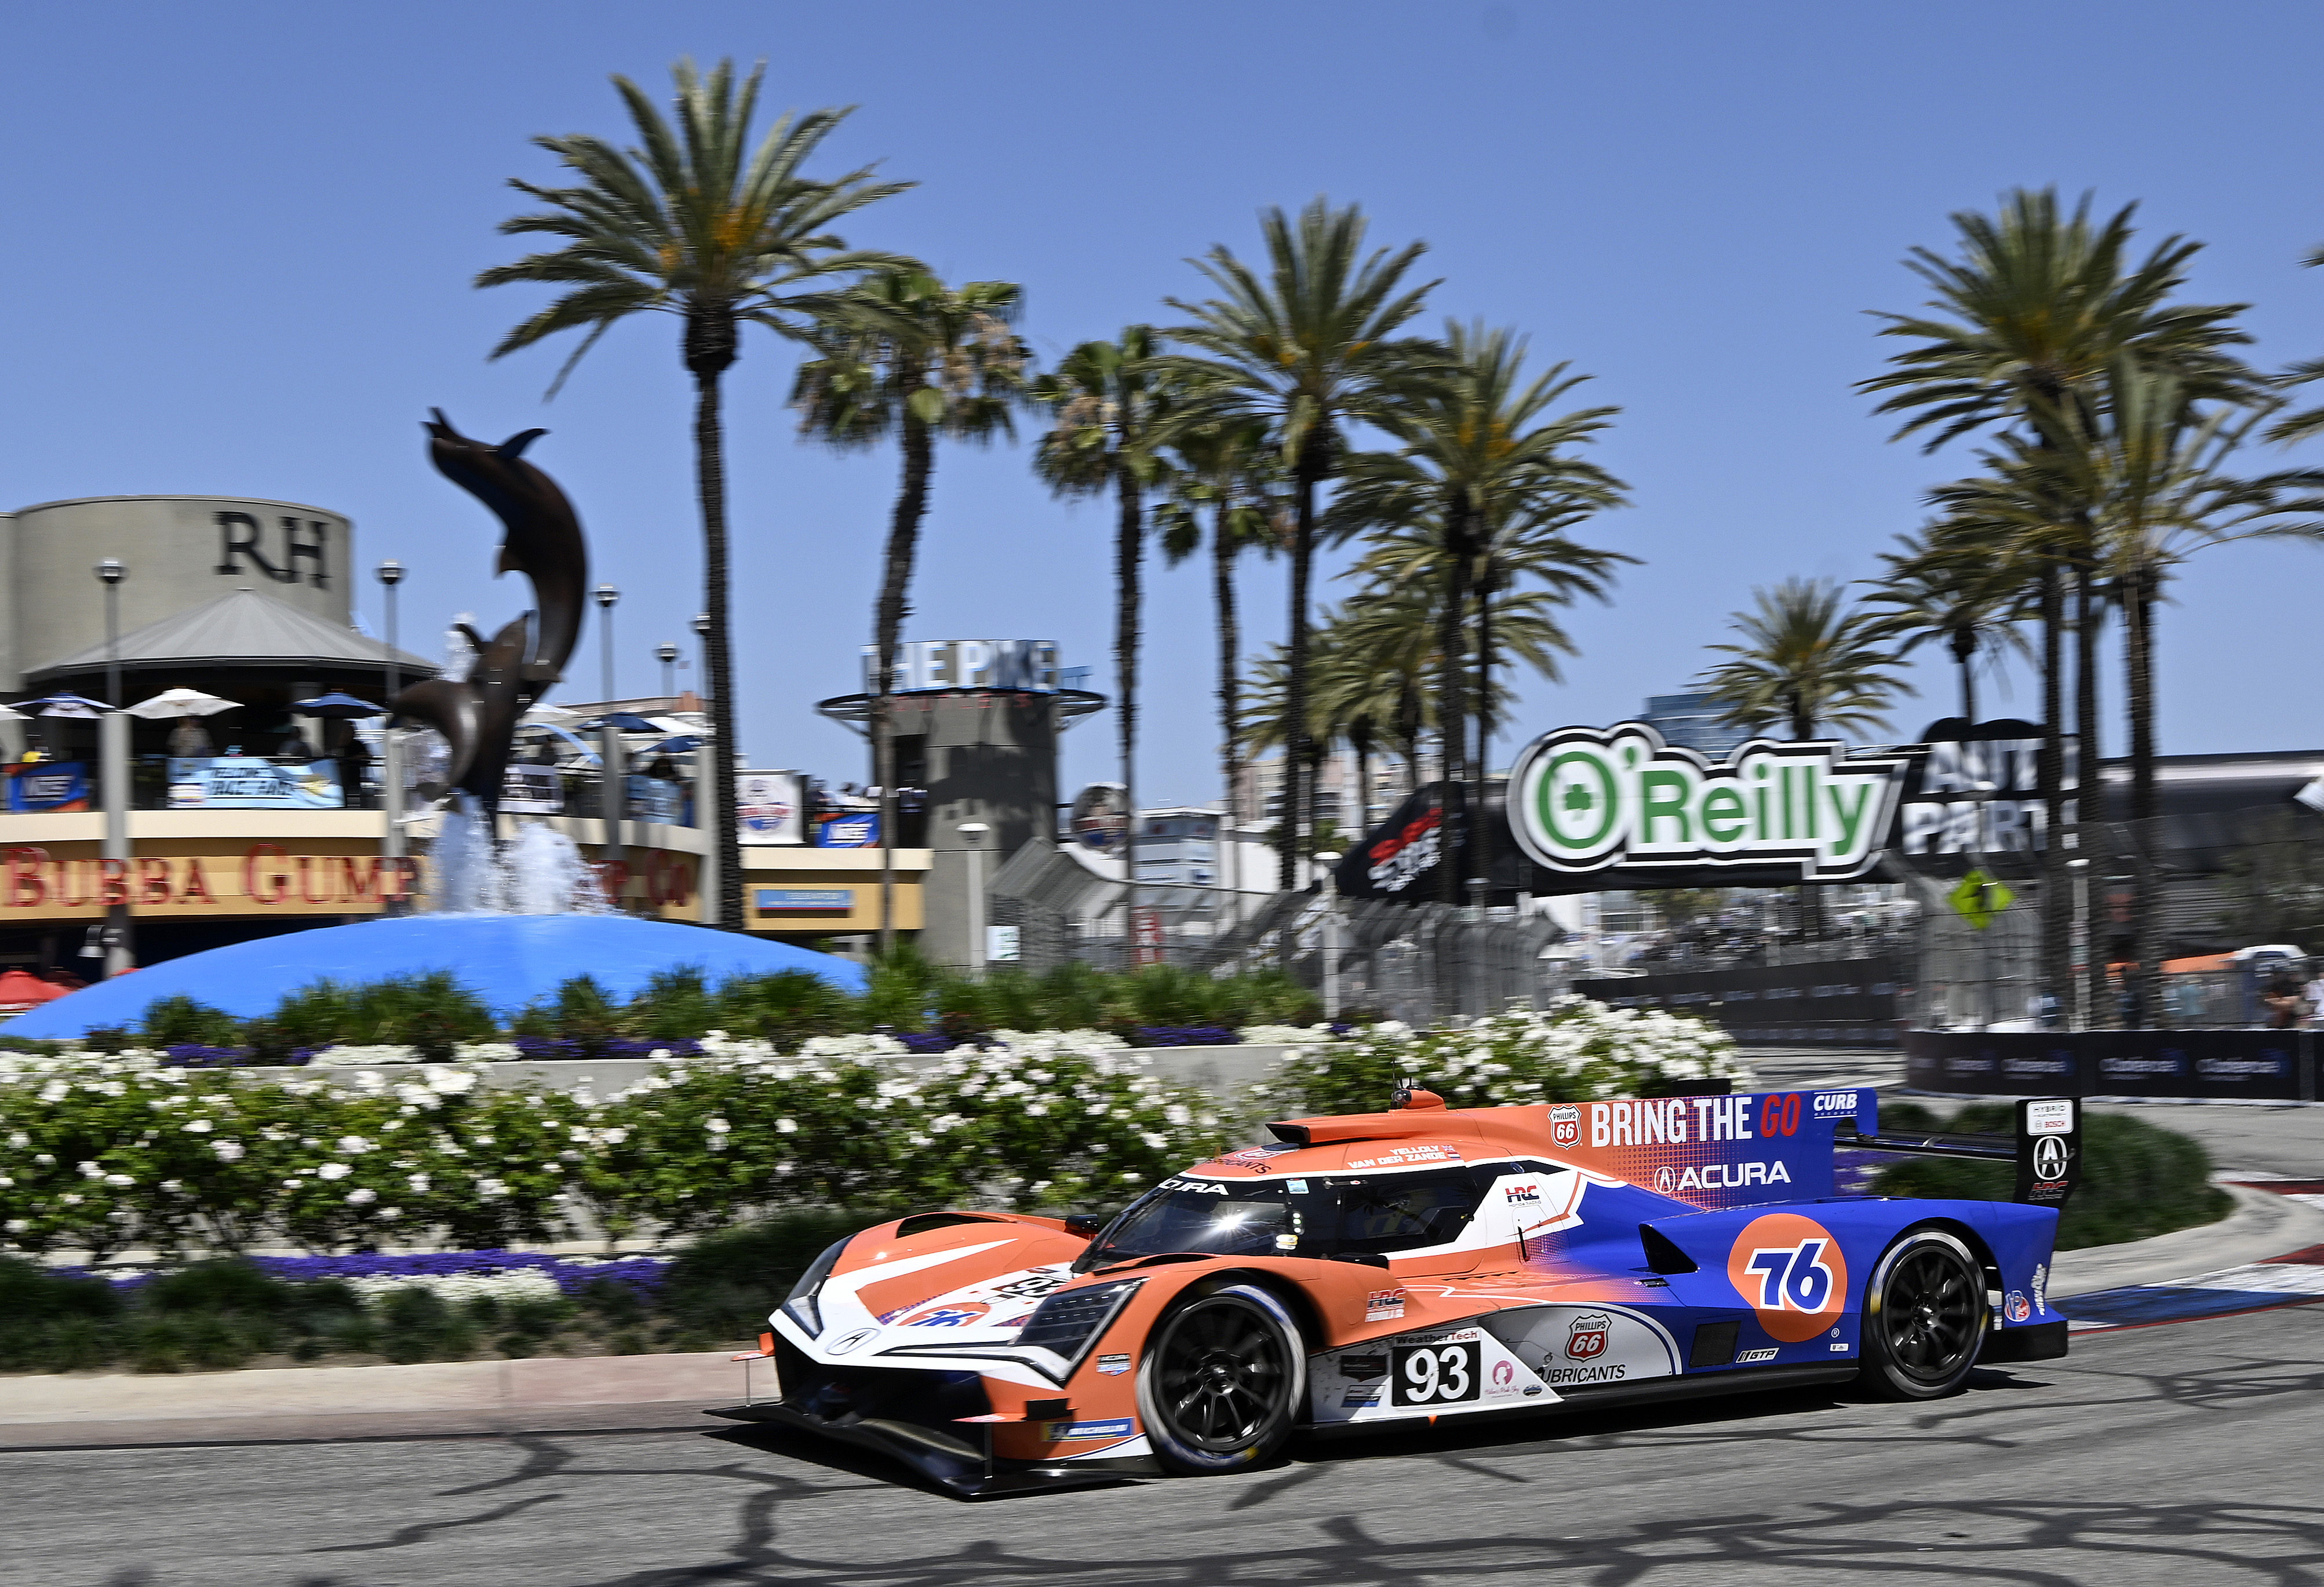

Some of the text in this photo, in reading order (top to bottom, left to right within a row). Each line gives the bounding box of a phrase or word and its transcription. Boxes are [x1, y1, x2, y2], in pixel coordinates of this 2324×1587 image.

[213, 510, 333, 590] RH
[1539, 746, 1874, 856] O'Reilly
[2, 847, 220, 908] BUBBA
[1813, 1093, 1858, 1111] CURB
[2034, 1104, 2066, 1112] HYBRID
[1553, 1111, 1576, 1121] PHILLIPS
[1591, 1093, 1801, 1147] BRING THE GO
[2044, 1121, 2066, 1129] BOSCH
[1557, 1123, 1575, 1140] 66
[1389, 1145, 1440, 1155] YELLOLY
[1347, 1152, 1447, 1169] VAN DER ZANDE
[1677, 1161, 1791, 1191] ACURA
[1505, 1185, 1540, 1203] HRC
[1744, 1238, 1833, 1315] 76
[1367, 1287, 1407, 1309] HRC
[1575, 1320, 1607, 1331] PHILLIPS
[1396, 1331, 1477, 1344] WeatherTech
[1573, 1334, 1602, 1353] 66
[1750, 1350, 1776, 1360] GTP
[1405, 1346, 1470, 1402] 93
